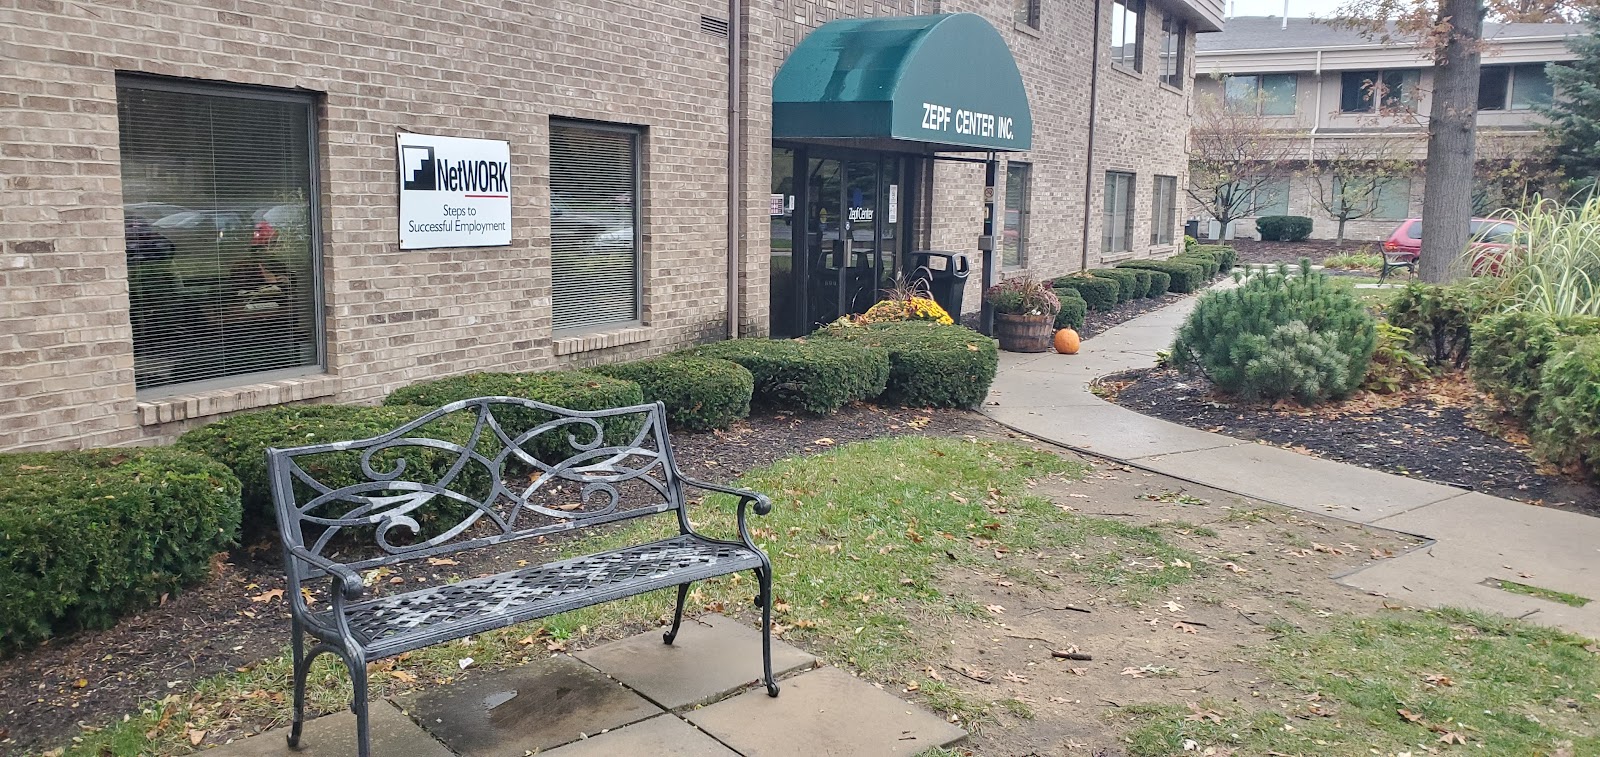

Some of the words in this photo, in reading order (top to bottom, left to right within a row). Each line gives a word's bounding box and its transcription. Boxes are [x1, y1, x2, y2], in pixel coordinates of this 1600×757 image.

[921, 102, 952, 131] ZEPF
[955, 109, 995, 137] CENTER
[997, 116, 1014, 140] INC.
[436, 158, 509, 192] NetWORK
[443, 204, 466, 219] Steps
[468, 207, 477, 216] to
[408, 220, 453, 232] Successful
[455, 220, 506, 234] Employment
